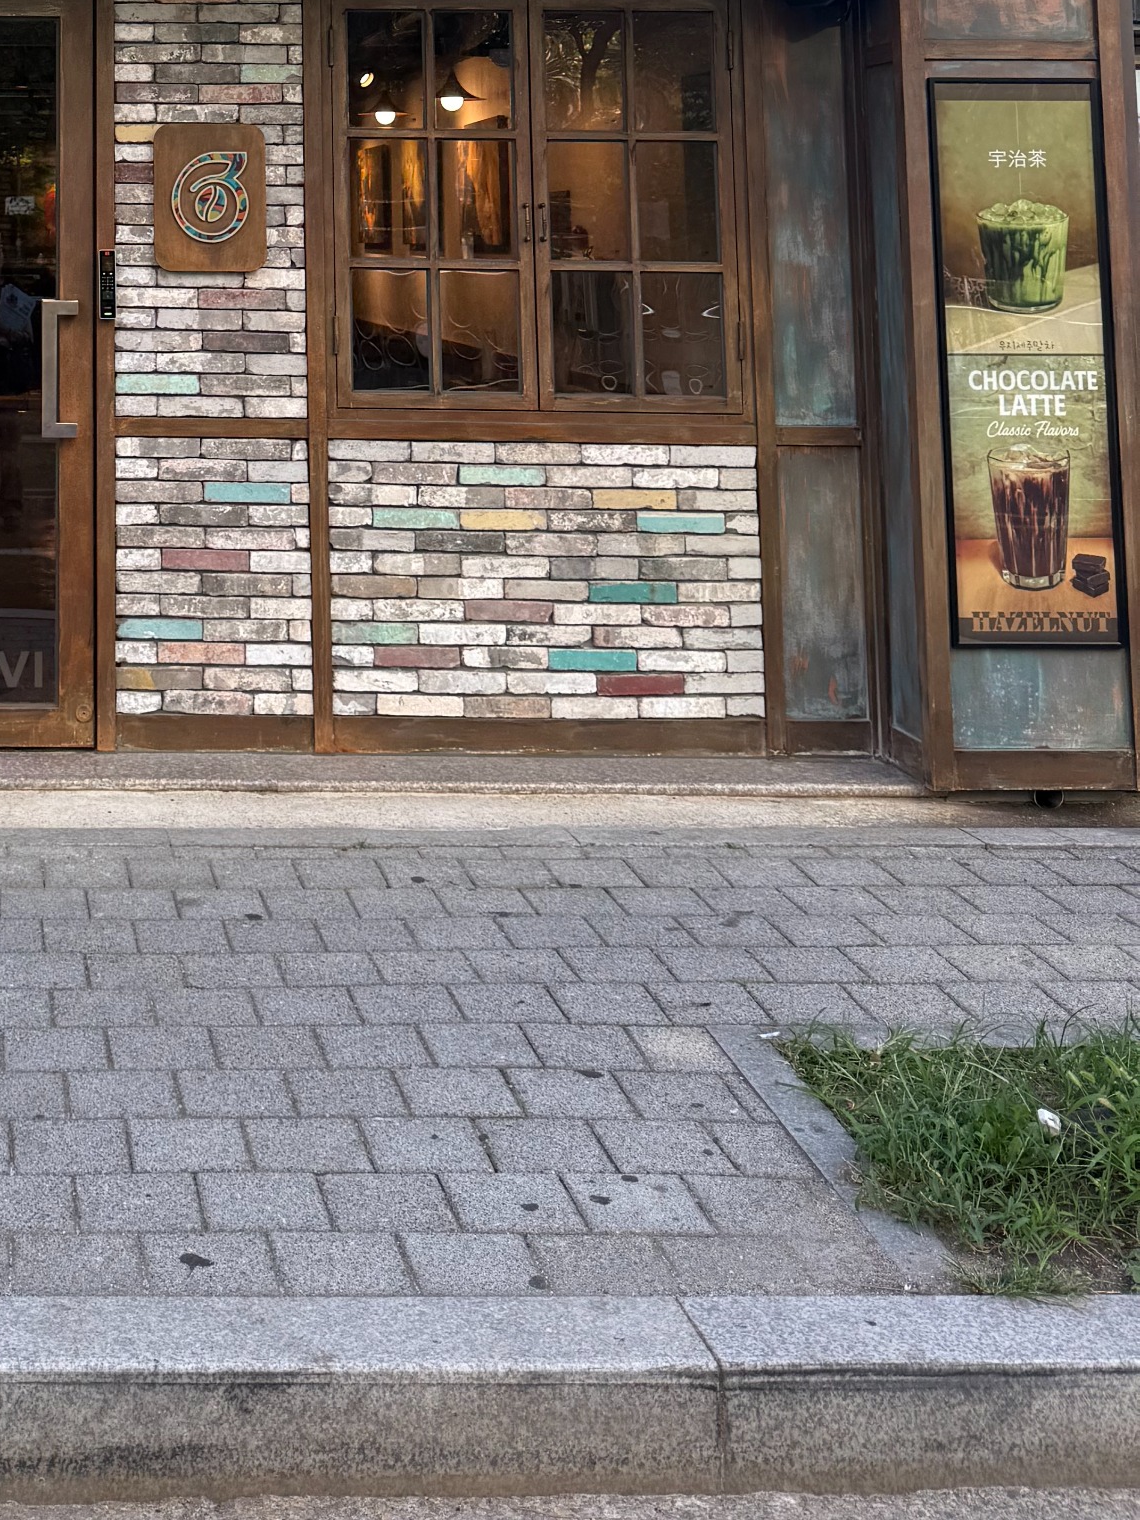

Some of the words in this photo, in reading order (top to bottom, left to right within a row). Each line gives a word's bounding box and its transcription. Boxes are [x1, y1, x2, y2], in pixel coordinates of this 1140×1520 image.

[988, 149, 1047, 169] 宇治茶
[999, 340, 1055, 352] 우지제주말차
[968, 370, 1099, 391] CHOCOLATE
[998, 394, 1066, 416] LATTE
[986, 420, 1031, 438] Classic
[1035, 420, 1079, 438] Flavors
[971, 611, 1112, 633] HAZELNUT
